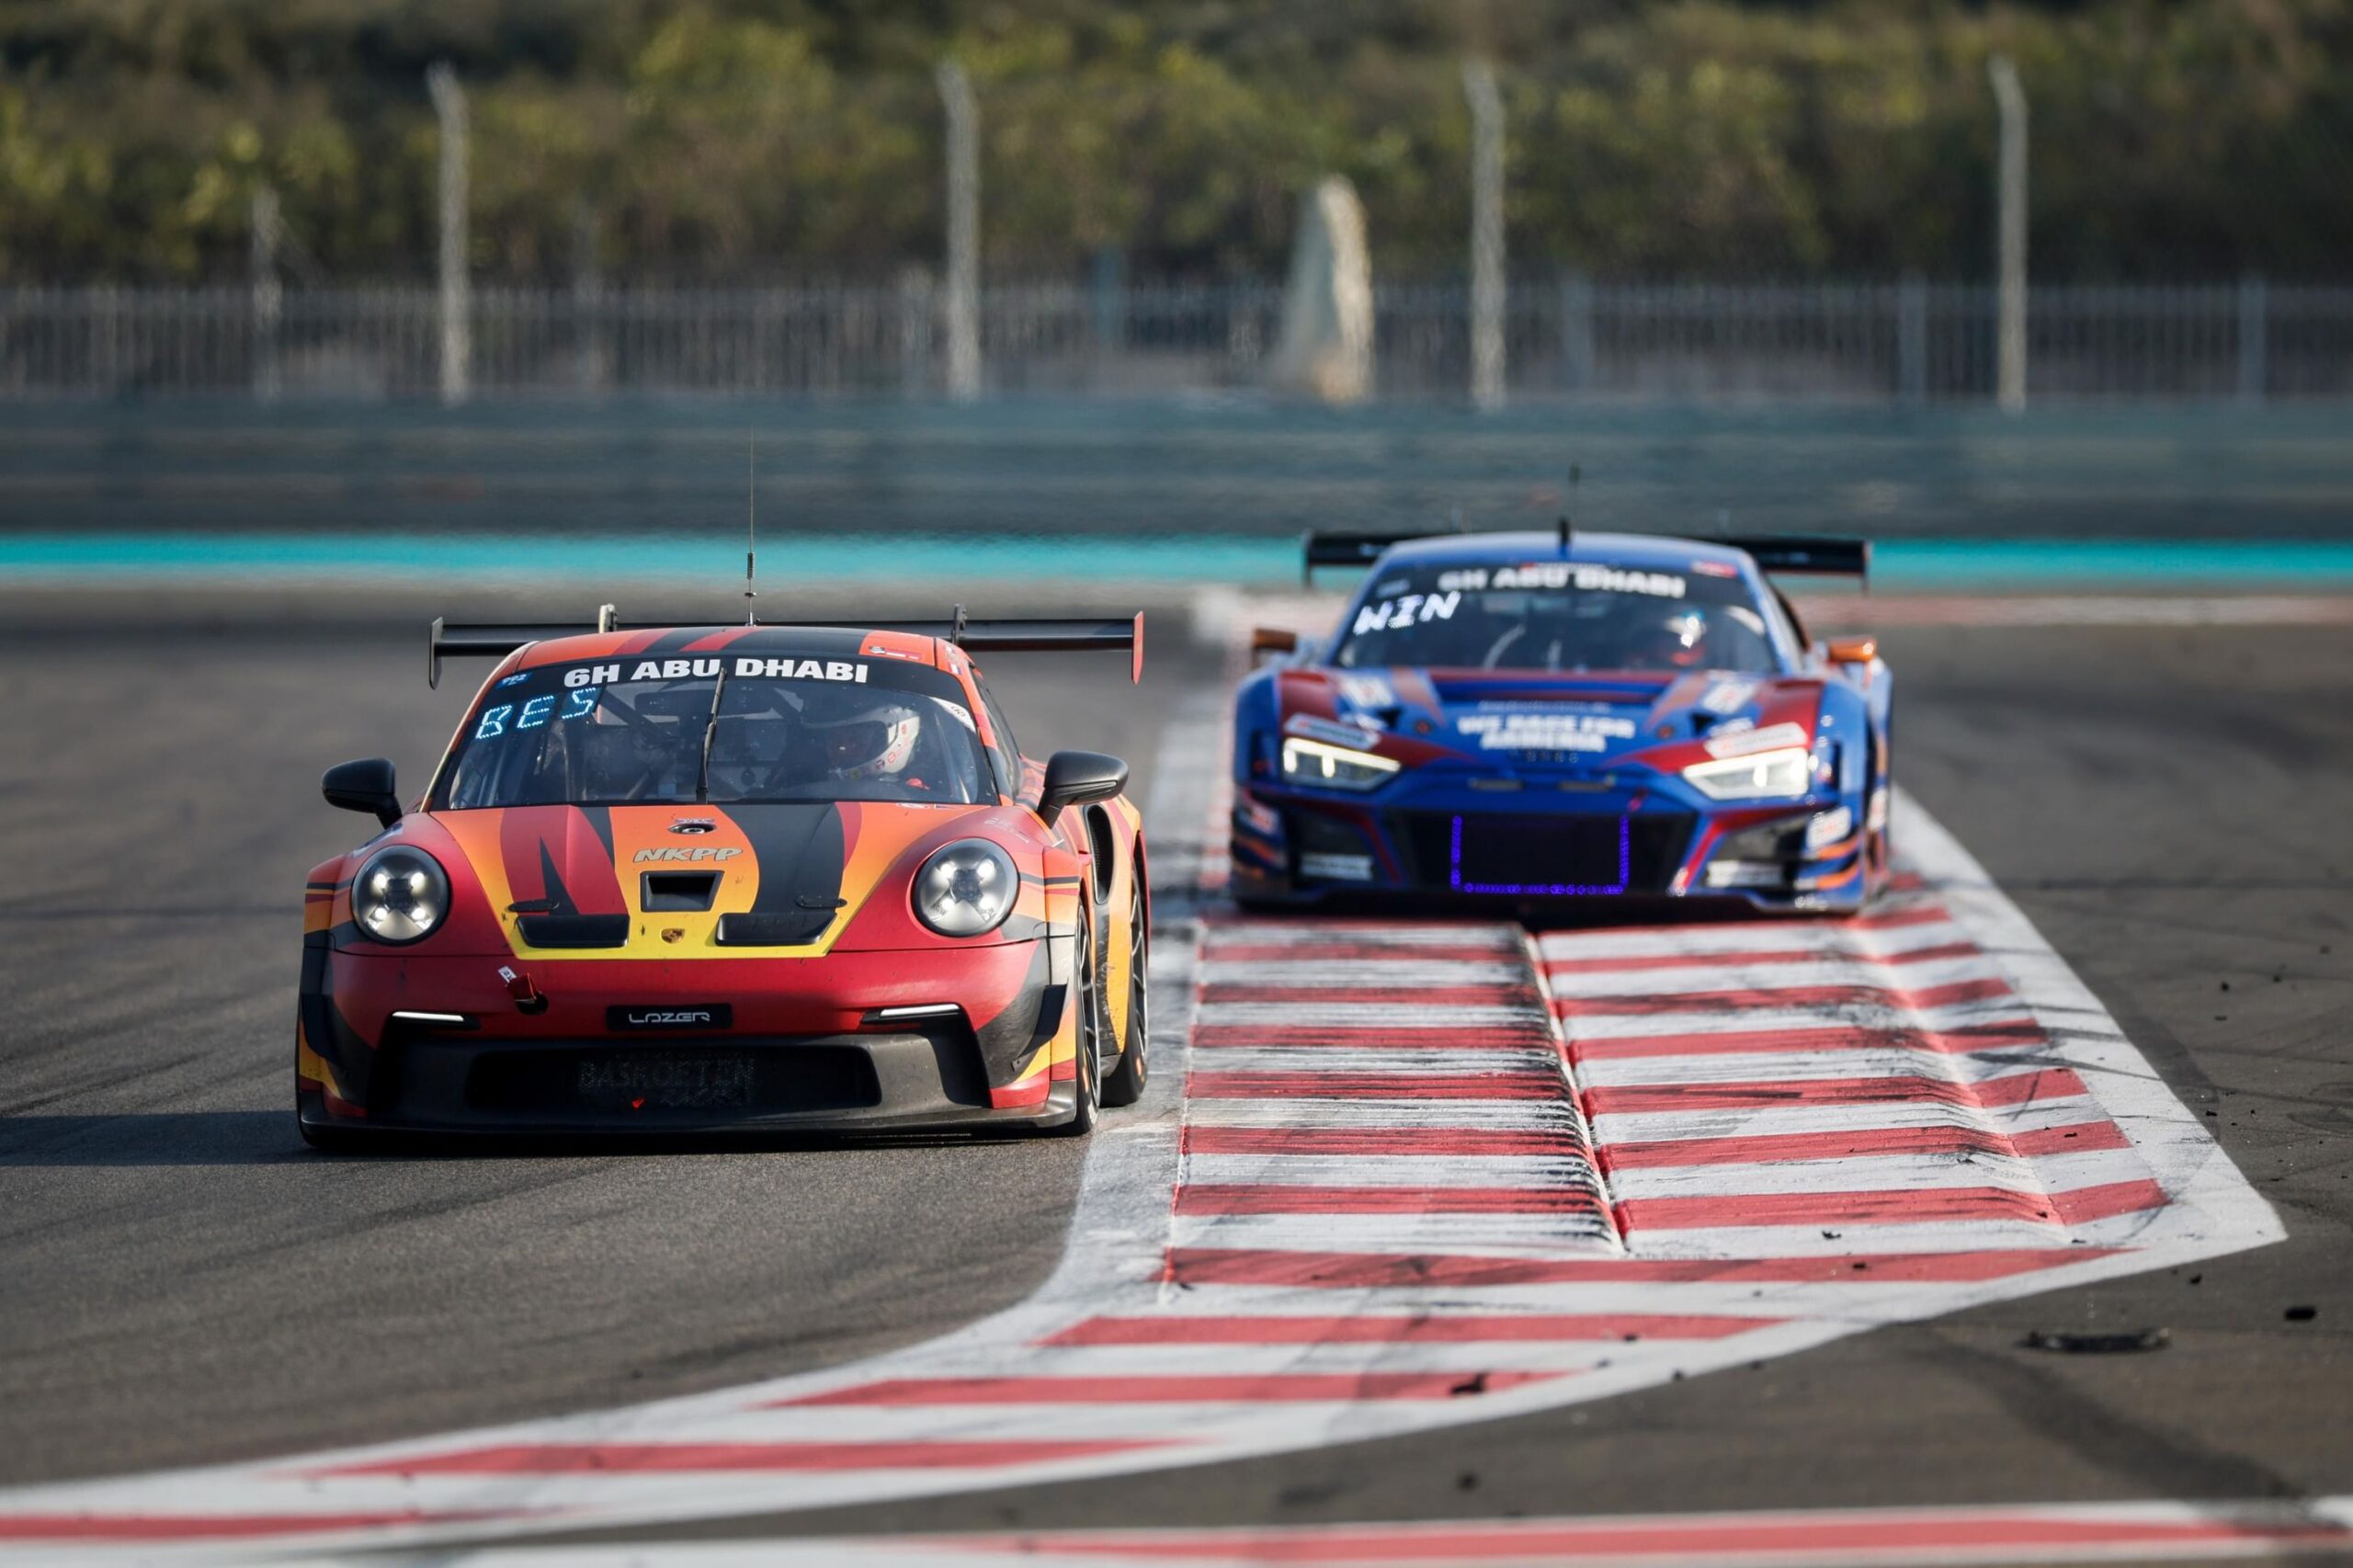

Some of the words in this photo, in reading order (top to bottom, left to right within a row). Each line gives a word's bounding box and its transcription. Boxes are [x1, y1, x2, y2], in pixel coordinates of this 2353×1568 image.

[1492, 565, 1570, 589] ABU
[1574, 566, 1687, 599] DHABI
[563, 664, 620, 687] 6H
[631, 659, 722, 681] ABU
[735, 658, 868, 683] DHABI
[475, 687, 597, 739] BES
[632, 846, 744, 863] NKPP
